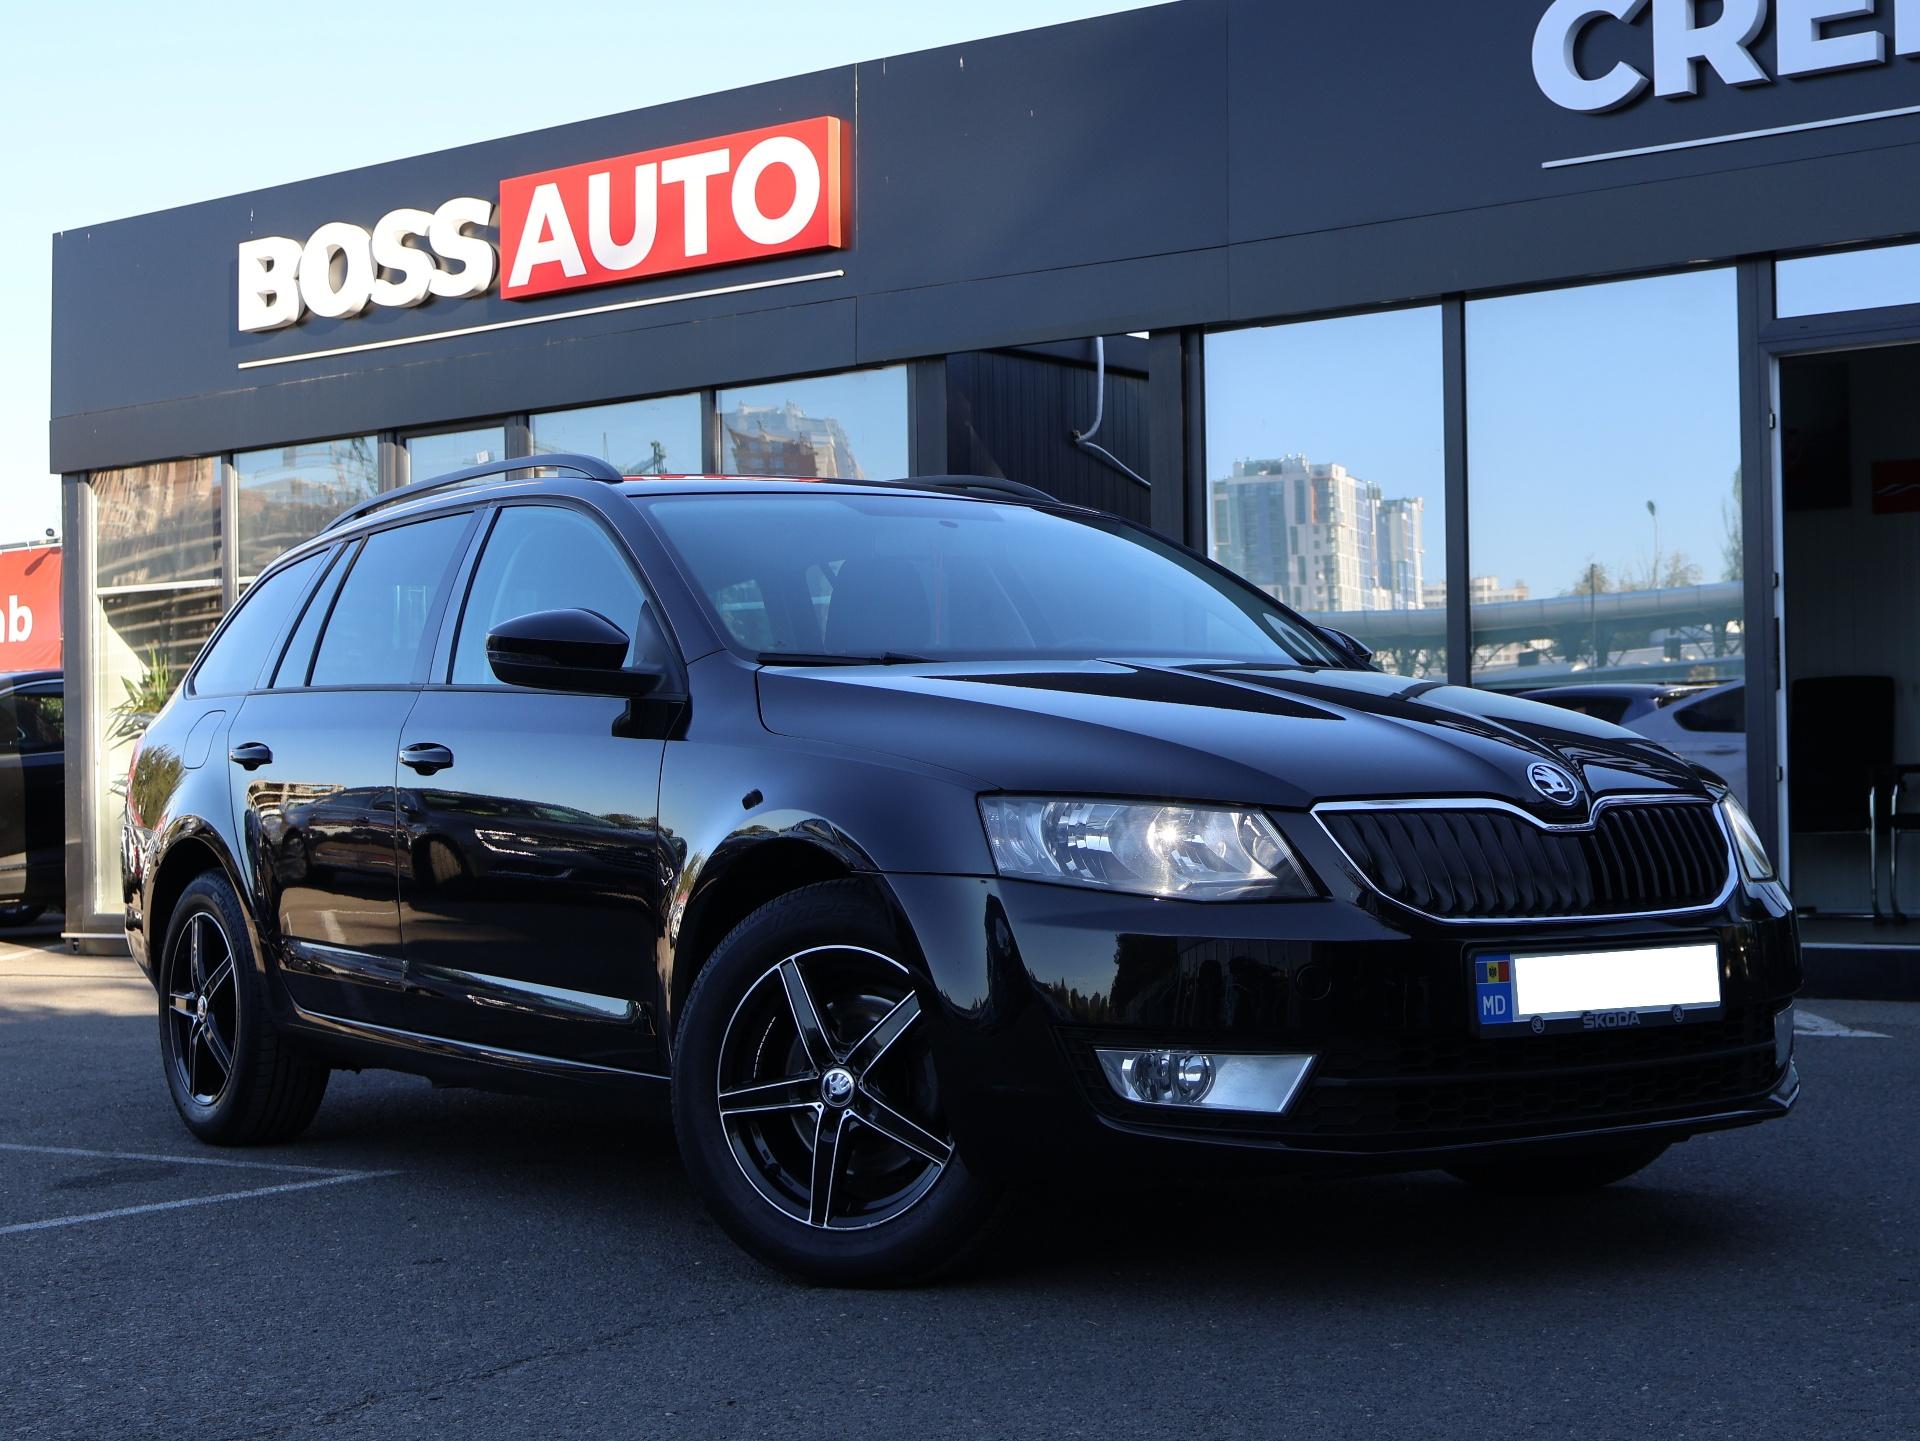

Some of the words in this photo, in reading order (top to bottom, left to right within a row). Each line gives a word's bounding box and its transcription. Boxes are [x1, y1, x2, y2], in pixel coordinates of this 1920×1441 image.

[1532, 0, 1920, 114] CRE
[238, 197, 497, 333] BOSS
[507, 136, 820, 289] AUTO
[1482, 994, 1506, 1016] MD
